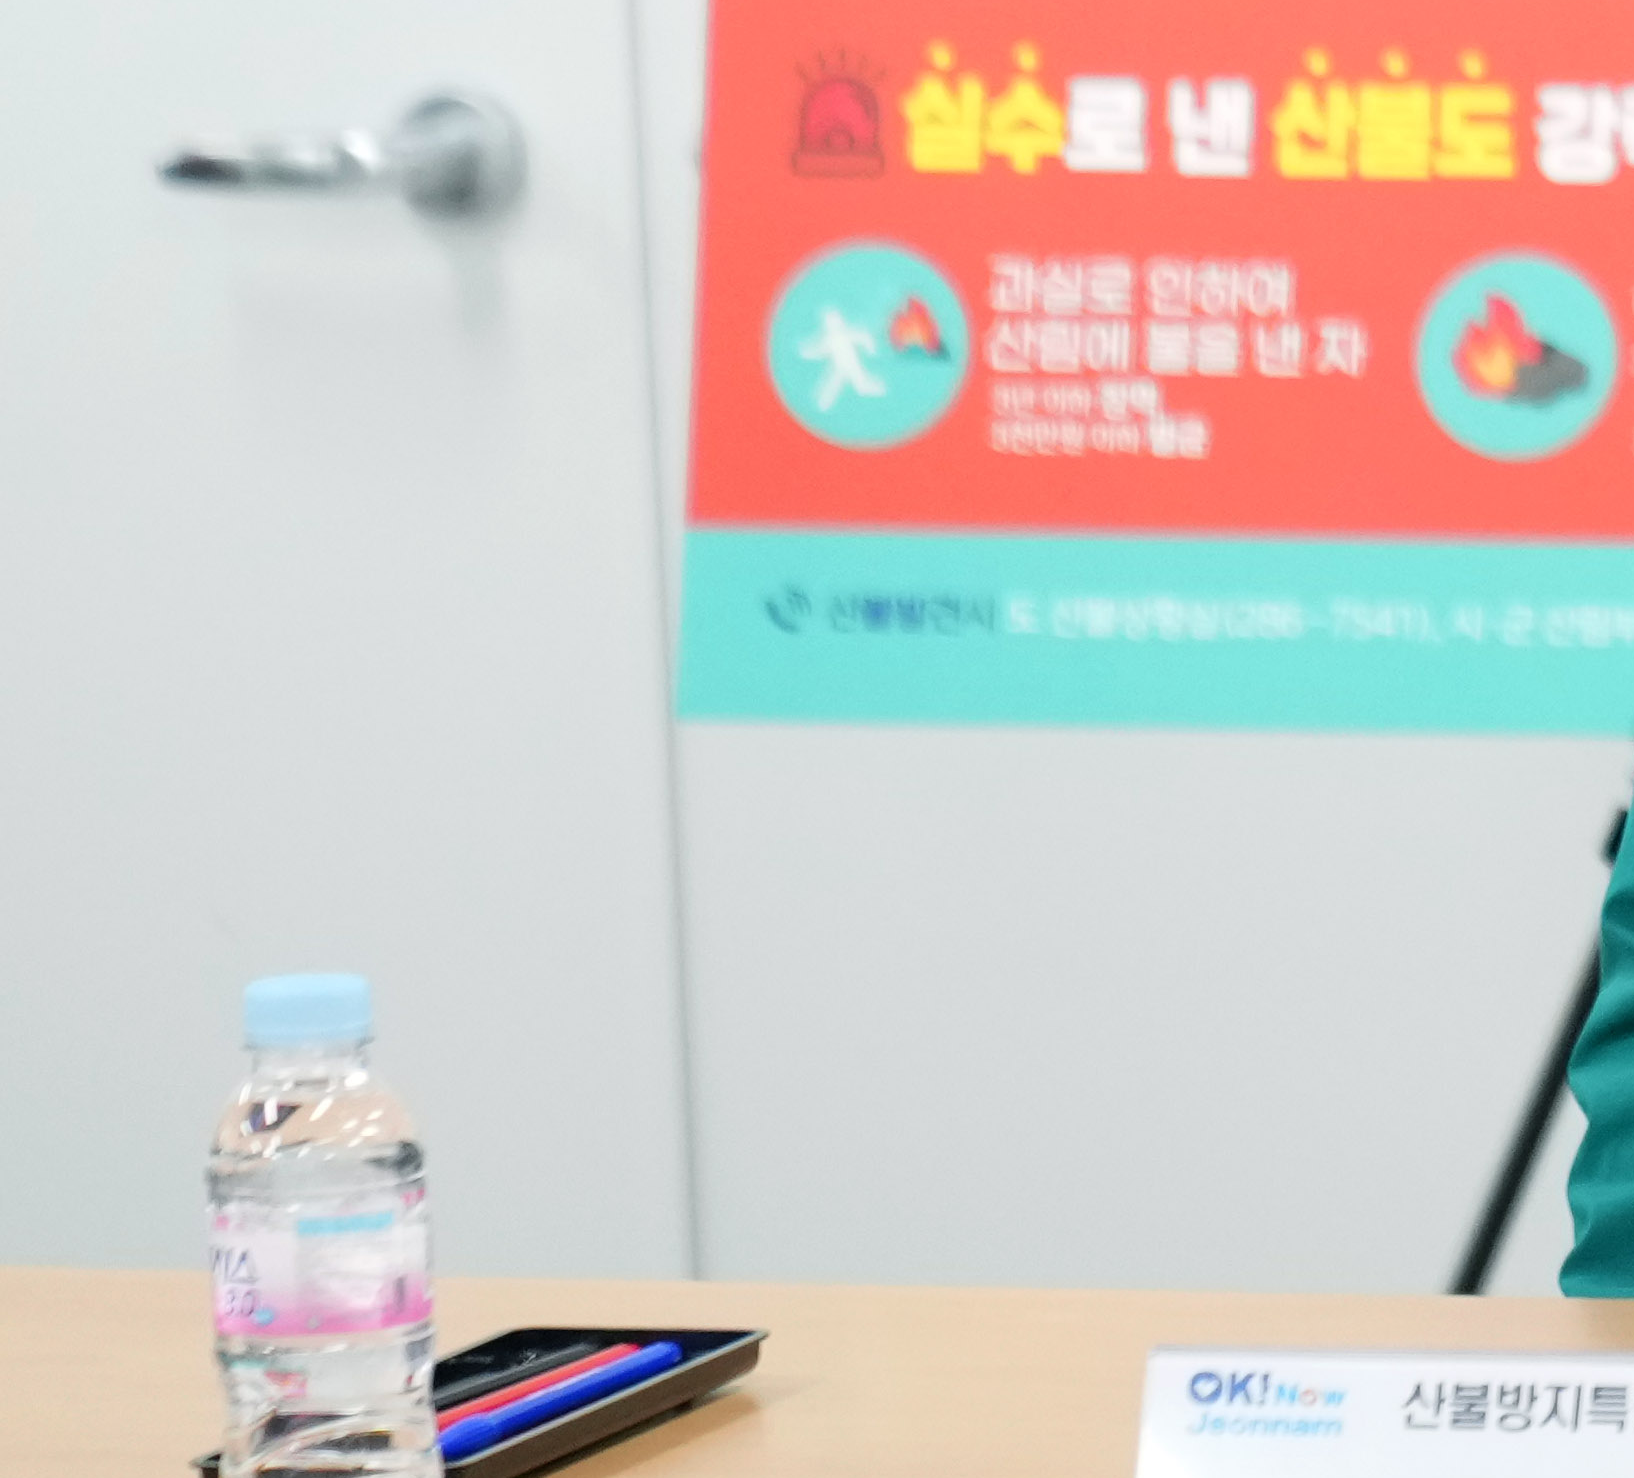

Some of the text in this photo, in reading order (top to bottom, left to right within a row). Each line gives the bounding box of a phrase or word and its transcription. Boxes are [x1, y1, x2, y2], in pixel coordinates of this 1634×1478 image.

[904, 73, 1147, 178] 실수로
[1168, 77, 1256, 180] 낸
[1272, 76, 1518, 182] 산불도
[988, 255, 1296, 319] 과실로 인하여
[986, 320, 1133, 375] 산림에
[1255, 324, 1304, 378] 낸
[1316, 322, 1367, 378] 자
[1188, 1369, 1348, 1408] OK! Now
[1186, 1410, 1343, 1438] Jeonnam
